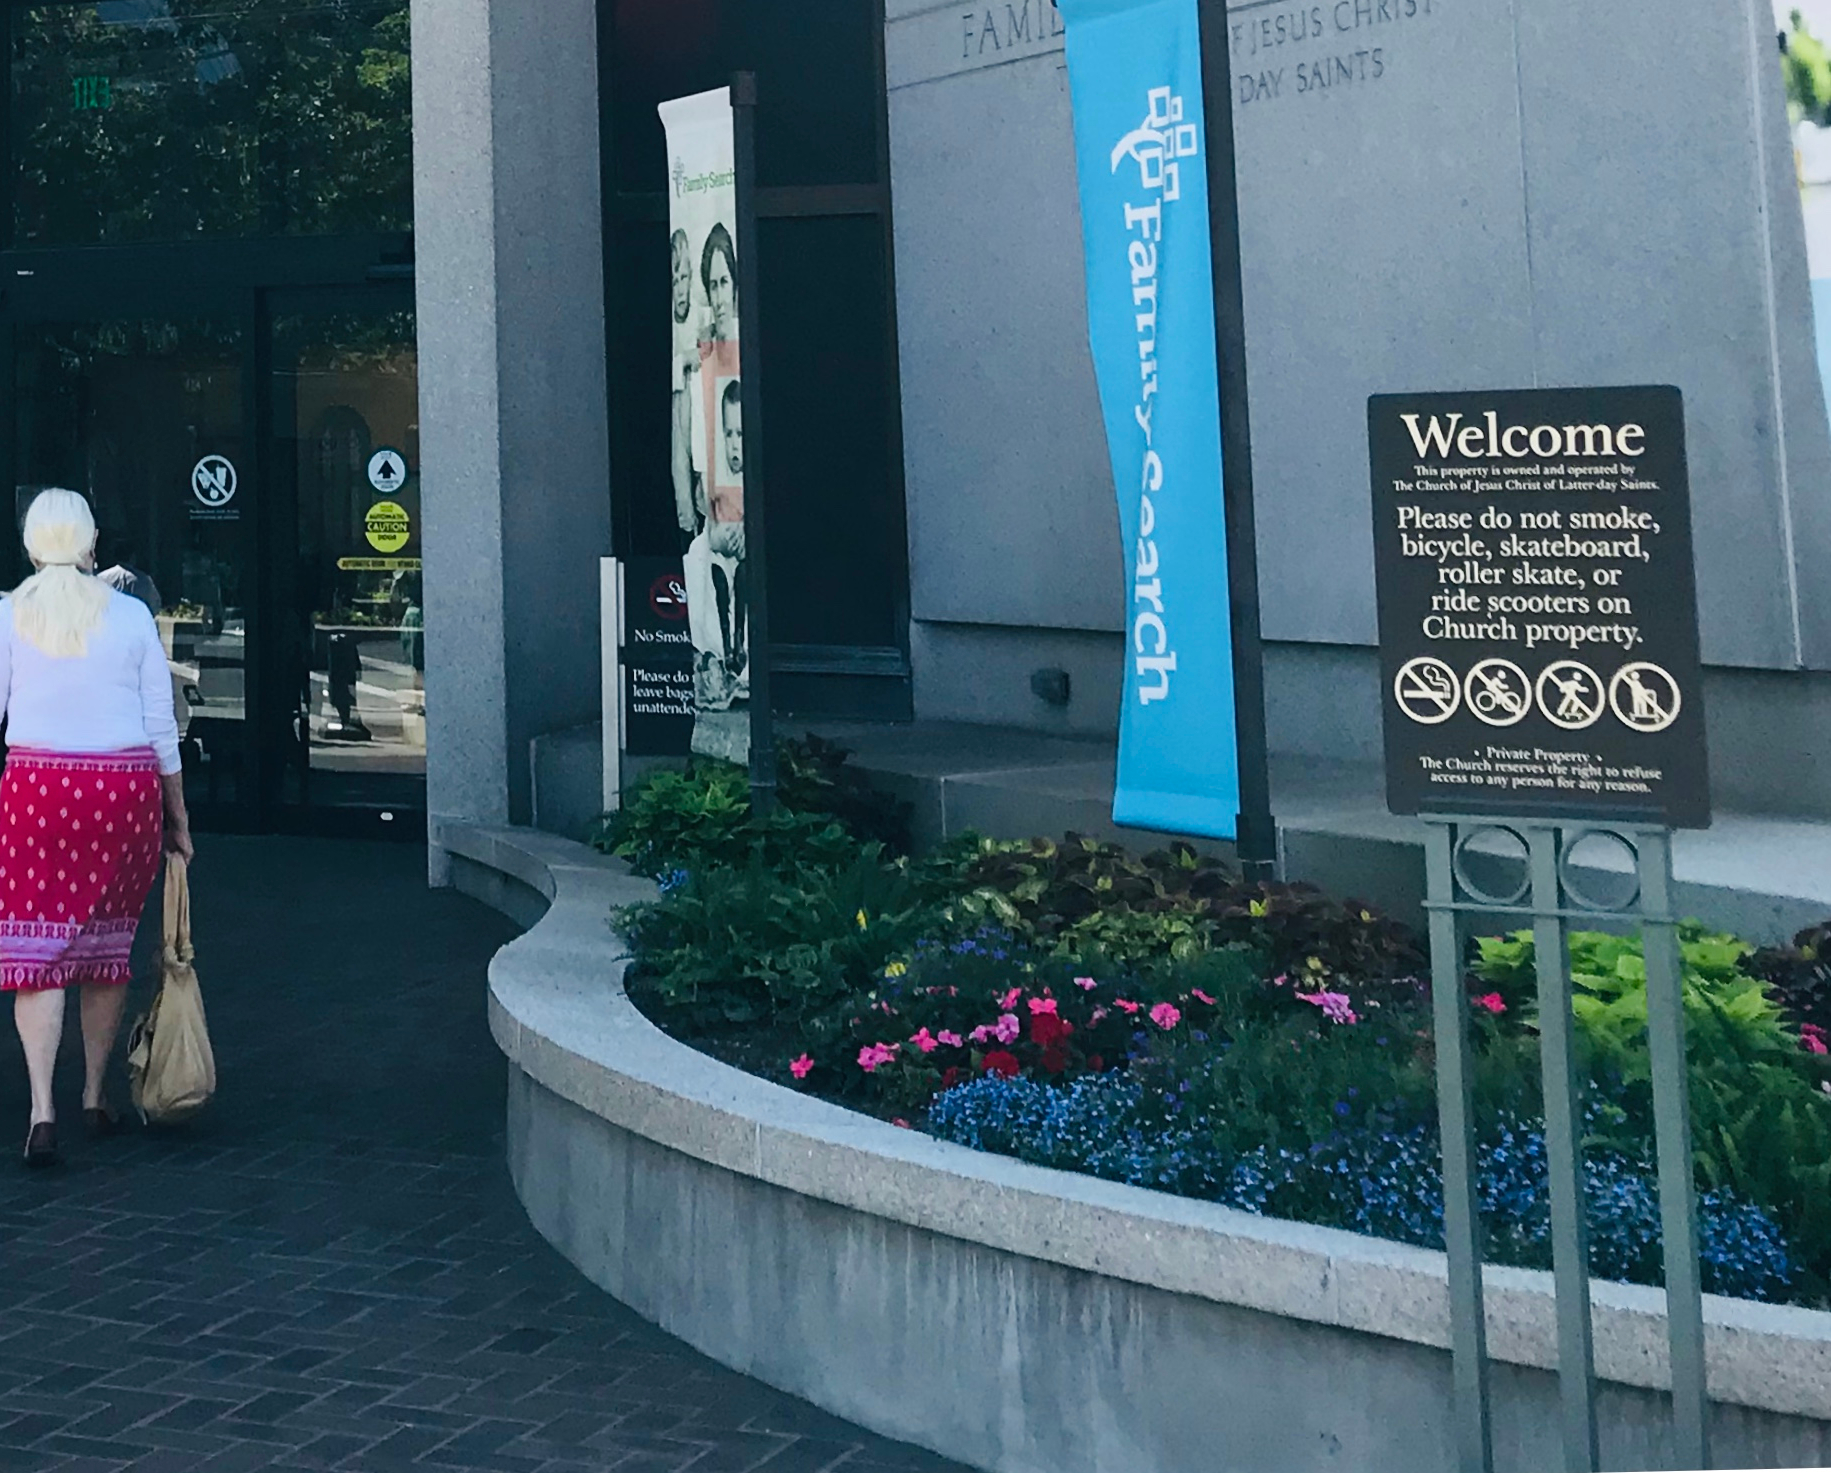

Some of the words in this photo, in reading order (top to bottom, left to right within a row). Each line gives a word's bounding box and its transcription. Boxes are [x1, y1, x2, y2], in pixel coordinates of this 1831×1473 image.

[1250, 7, 1322, 55] JESUS
[1297, 48, 1384, 93] SAINTS
[1400, 410, 1645, 459] Welcome
[1414, 465, 1438, 476] This
[1441, 466, 1488, 478] property
[1491, 465, 1500, 475] is
[1503, 465, 1540, 475] owned
[1543, 465, 1564, 475] and
[1567, 464, 1618, 477] operated
[1621, 464, 1636, 477] by
[1393, 480, 1413, 491] The
[1416, 480, 1457, 491] Church
[1460, 480, 1471, 491] of
[1472, 480, 1502, 493] Jesus
[1505, 480, 1541, 491] Christ
[1544, 479, 1556, 490] of
[367, 522, 407, 532] CAUTION
[1397, 506, 1472, 529] Please
[1479, 507, 1512, 529] do
[1520, 511, 1561, 529] not
[1569, 506, 1660, 534] smoke,
[1402, 534, 1493, 563] bicycle,
[1499, 534, 1649, 562] skateboard,
[1438, 562, 1505, 584] roller
[1512, 562, 1586, 591] skate,
[1593, 569, 1621, 585] or
[1432, 590, 1480, 612] ride
[1488, 591, 1589, 614] scooters
[1598, 598, 1631, 614] on
[635, 629, 654, 642] No
[656, 630, 691, 643] Smok
[1423, 615, 1517, 640] Church
[1525, 618, 1643, 649] property.
[633, 669, 670, 682] Please
[673, 670, 689, 683] do
[633, 685, 663, 698] leave
[666, 685, 694, 702] bags
[633, 702, 695, 714] unattende
[1486, 746, 1530, 760] Private
[1534, 748, 1589, 763] Property
[1419, 756, 1442, 769] The
[1445, 757, 1491, 771] Church
[1495, 761, 1544, 773] reserves
[1548, 762, 1567, 775] the
[1571, 762, 1602, 778] right
[1605, 767, 1619, 777] to
[1622, 766, 1662, 779] refuse
[1430, 772, 1467, 783] access
[1470, 774, 1483, 784] to
[1486, 776, 1507, 788] any
[1512, 777, 1554, 789] person
[1557, 776, 1575, 789] for
[1580, 780, 1600, 792] any
[1605, 781, 1652, 793] reason.
